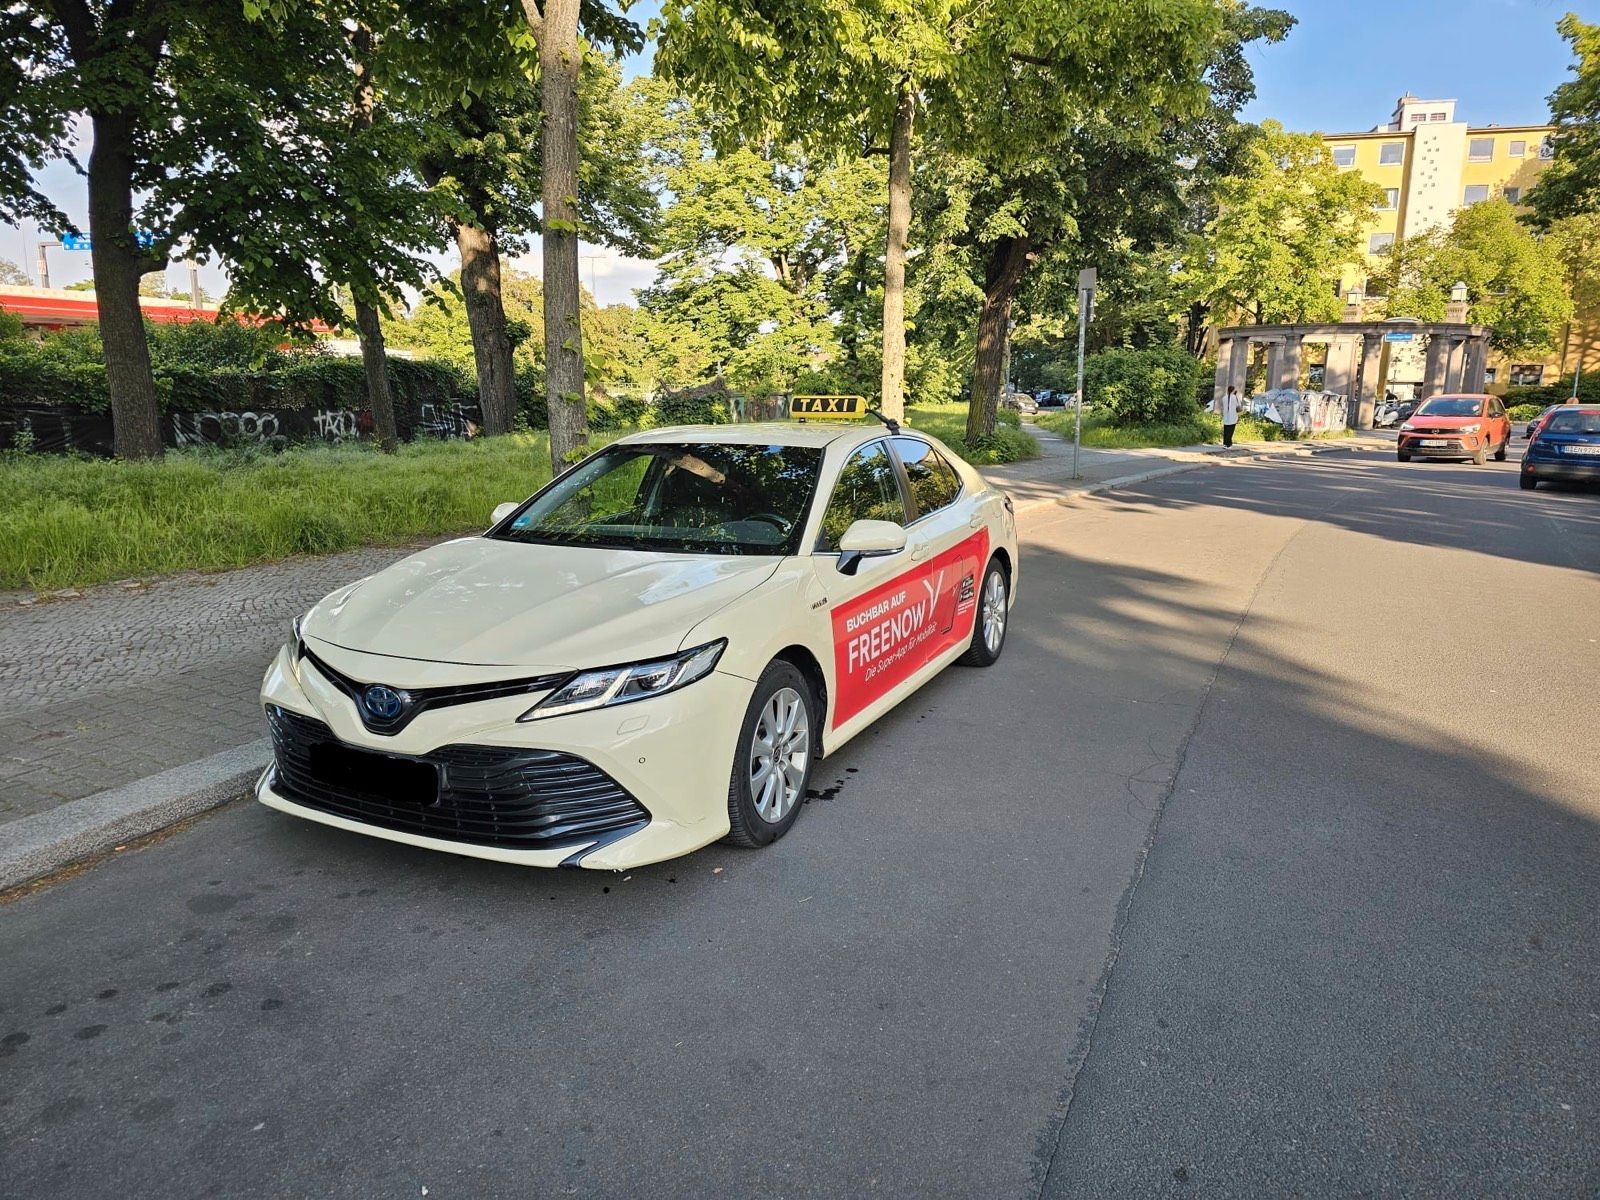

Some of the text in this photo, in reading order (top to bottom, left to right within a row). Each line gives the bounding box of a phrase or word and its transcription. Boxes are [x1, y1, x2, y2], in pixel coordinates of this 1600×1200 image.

[800, 398, 849, 412] TAXI
[846, 600, 889, 633] BUCHBAR
[891, 590, 906, 609] AUF
[848, 600, 926, 674] FREENOW
[865, 665, 876, 682] Die
[877, 644, 908, 673] Super-App
